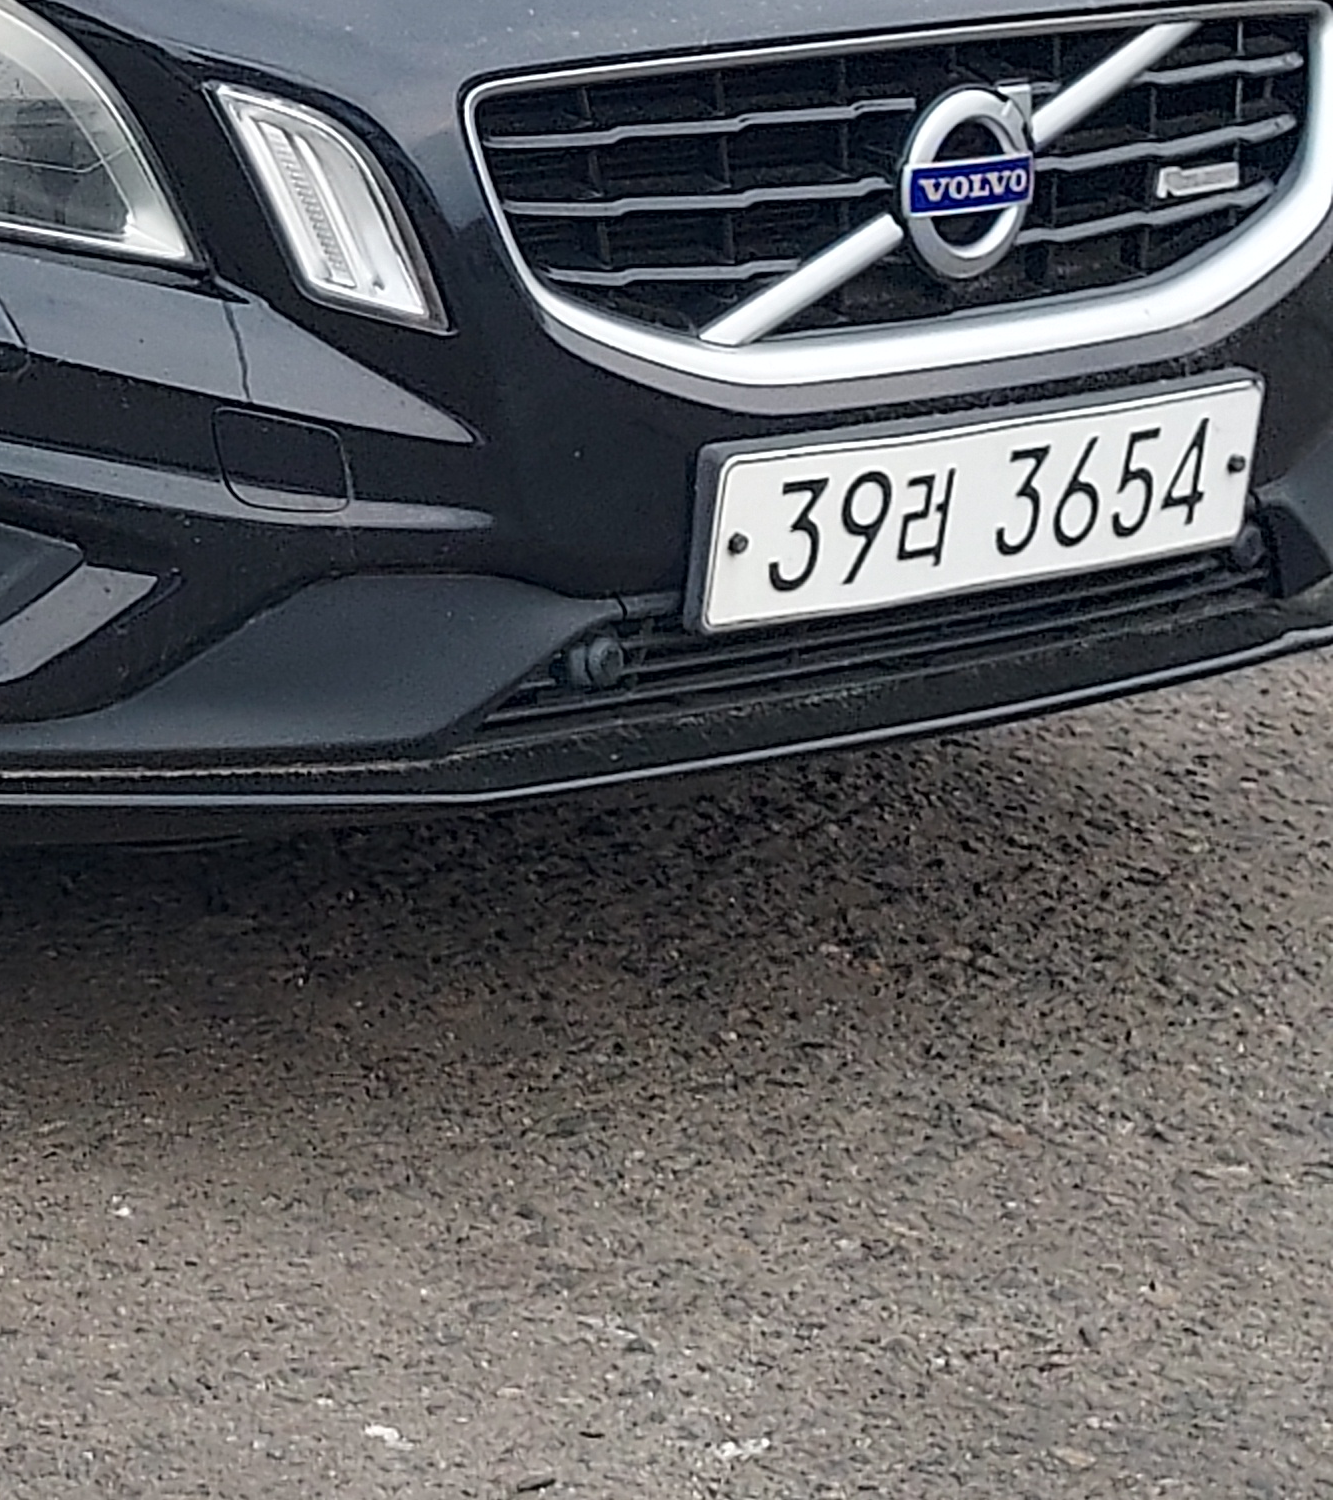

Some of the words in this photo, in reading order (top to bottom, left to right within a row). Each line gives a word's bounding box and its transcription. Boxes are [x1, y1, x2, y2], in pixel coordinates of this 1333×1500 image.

[919, 167, 1028, 202] VOLVO
[768, 467, 956, 592] 39러
[996, 417, 1210, 557] 3654
